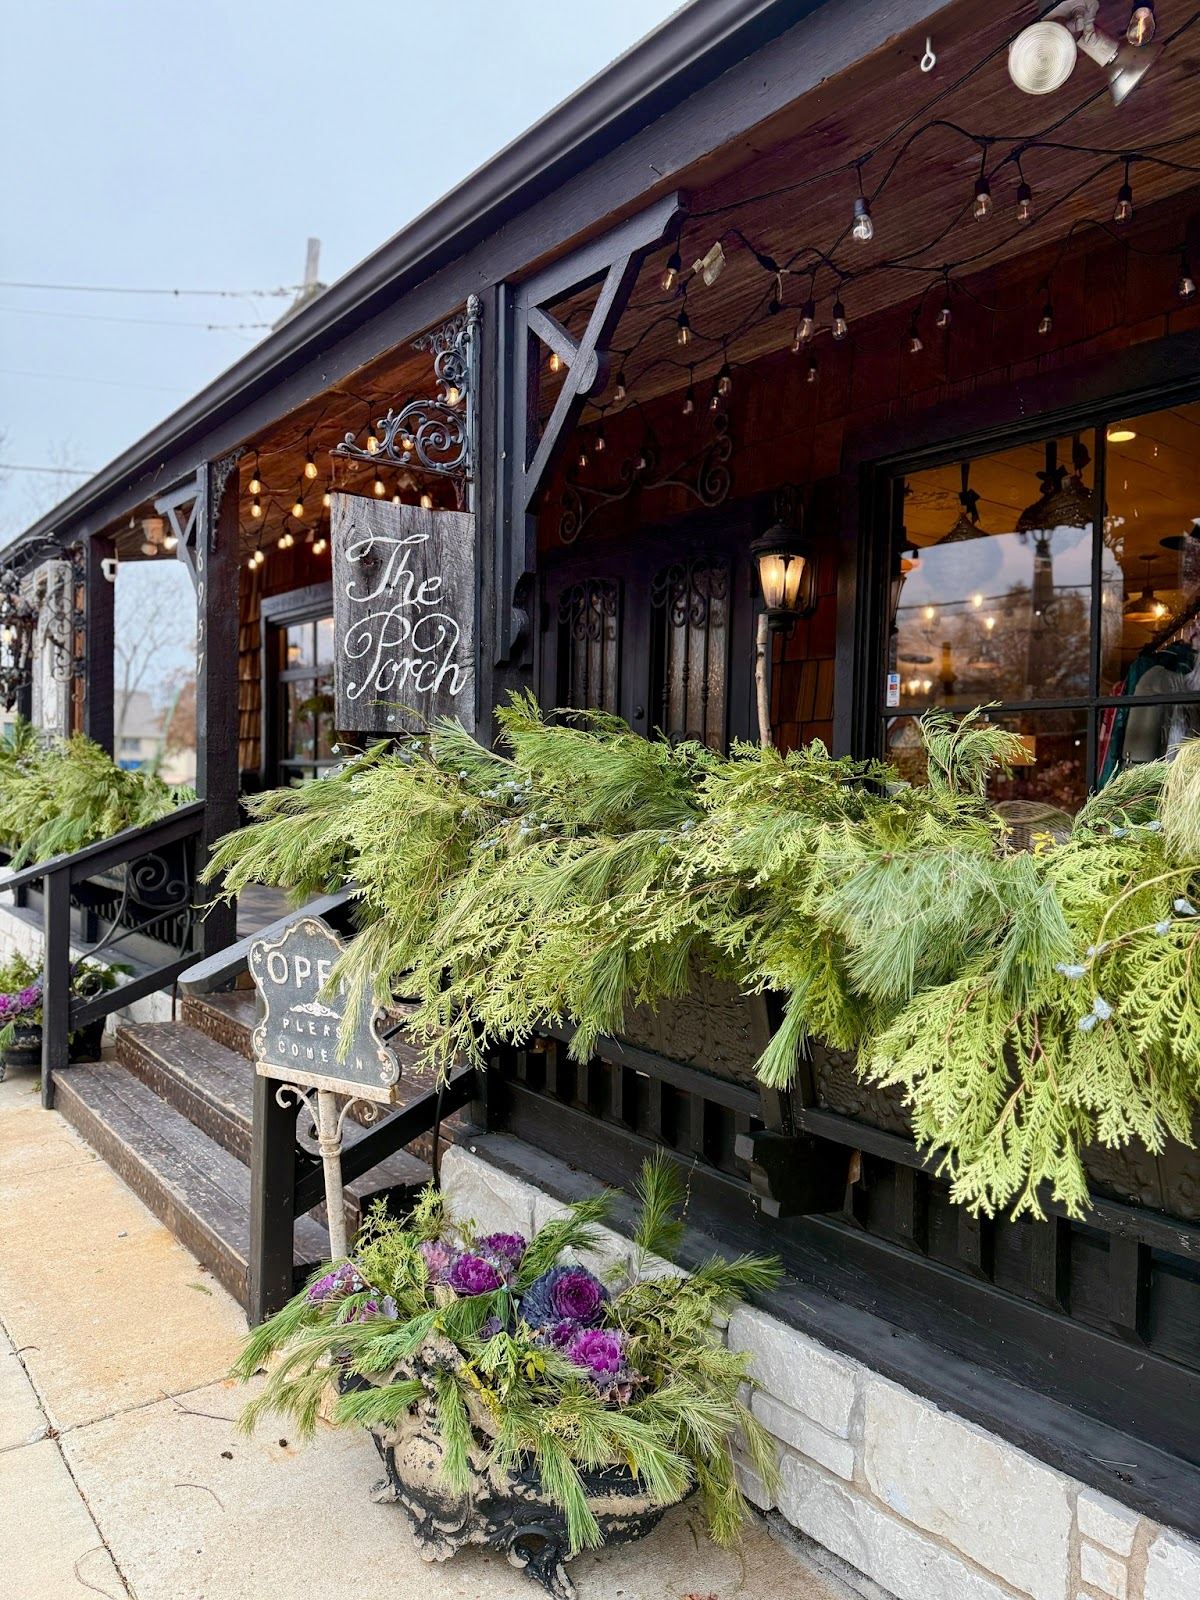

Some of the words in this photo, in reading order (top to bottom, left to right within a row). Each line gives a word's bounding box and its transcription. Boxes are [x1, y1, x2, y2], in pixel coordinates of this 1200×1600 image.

[345, 526, 446, 606] The
[344, 600, 468, 700] Porch
[278, 1040, 329, 1063] COME
[283, 1018, 347, 1041] PLEAS
